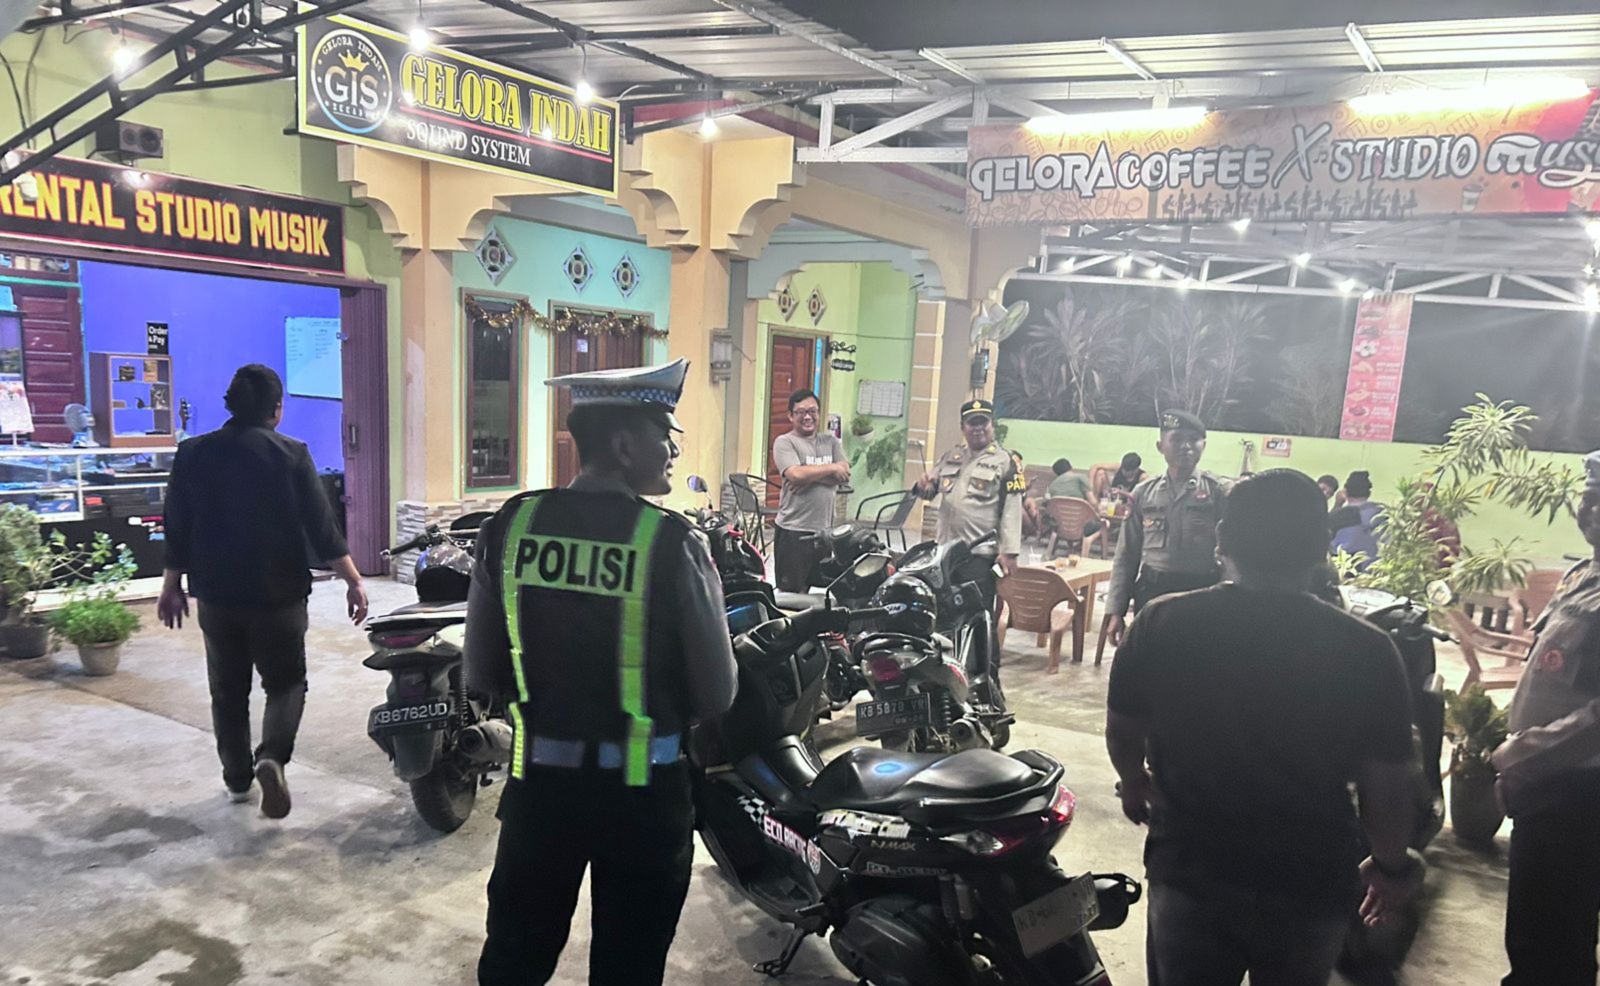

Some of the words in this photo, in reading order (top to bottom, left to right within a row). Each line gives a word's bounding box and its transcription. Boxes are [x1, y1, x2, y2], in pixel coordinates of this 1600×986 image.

[321, 36, 353, 55] GELORA
[357, 40, 383, 72] INDAH
[324, 65, 379, 110] GIS
[401, 54, 523, 132] GELORA
[530, 90, 611, 154] INDAH
[406, 119, 468, 151] SOUND
[470, 134, 532, 167] SYSTEM
[970, 140, 1117, 200] GELORA
[1115, 147, 1274, 191] COFFEE
[1271, 121, 1332, 190] X
[1329, 134, 1480, 182] STUDIO
[135, 189, 242, 246] STUDIO
[249, 206, 331, 257] MUSIK
[514, 537, 637, 593] POLISI
[374, 702, 447, 725] KB6762UD
[861, 705, 874, 718] KB
